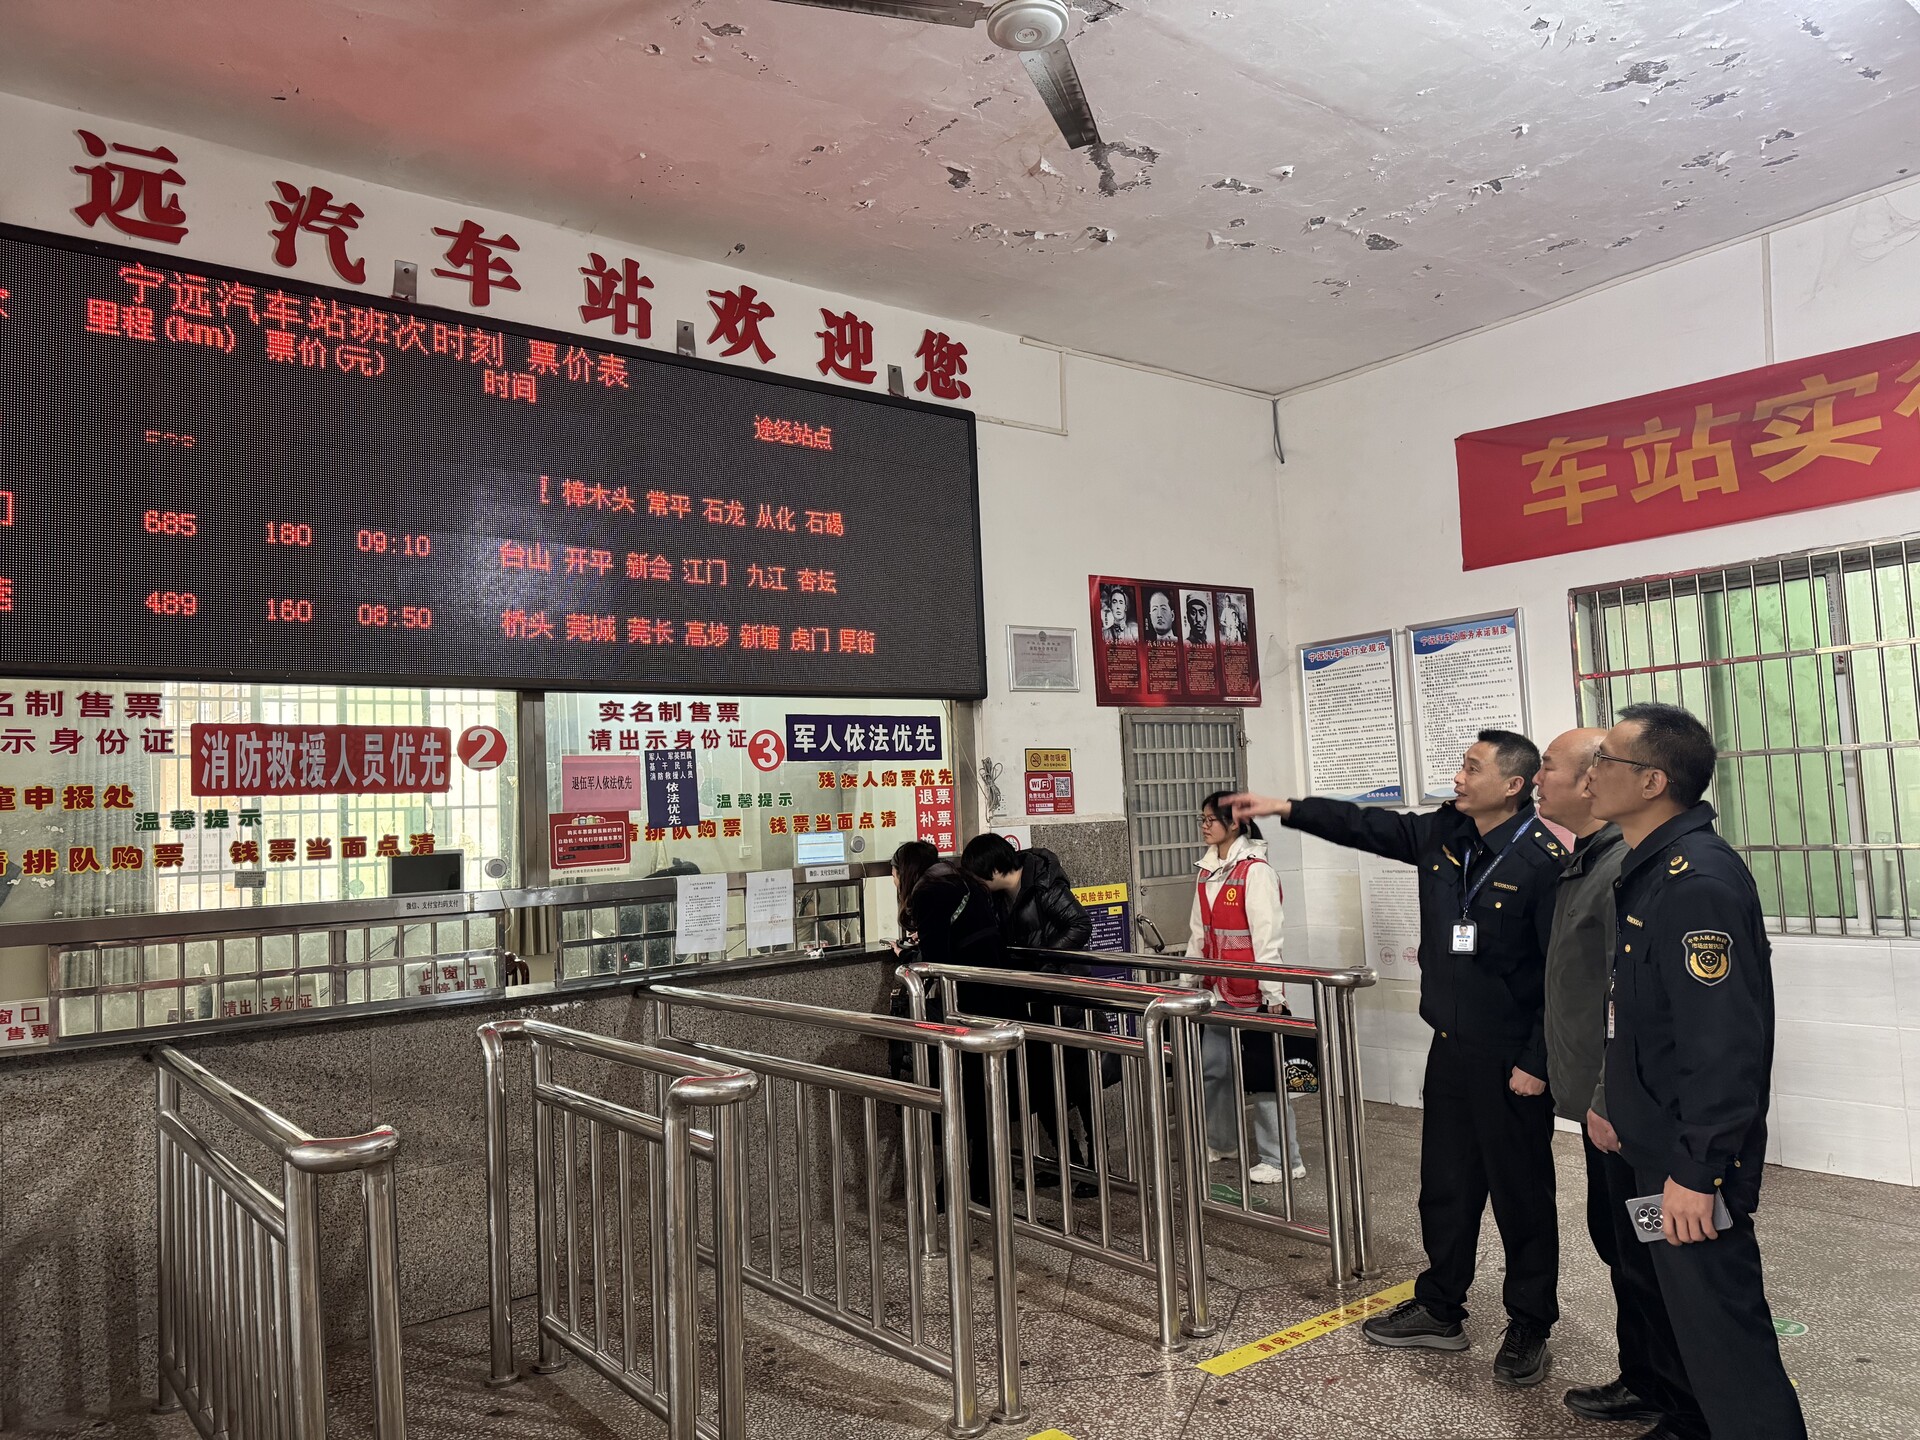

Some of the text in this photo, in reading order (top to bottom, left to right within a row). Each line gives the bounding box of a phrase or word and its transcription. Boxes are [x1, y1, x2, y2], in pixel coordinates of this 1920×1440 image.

[72, 128, 971, 400] 远汽车站欢迎您
[483, 369, 537, 404] 时间
[754, 414, 832, 451] 途经站点
[1521, 360, 1920, 526] 车站实
[562, 479, 635, 513] 樟木头
[646, 490, 691, 519] 常平
[703, 497, 745, 526] 石龙
[756, 504, 795, 532] 从化
[806, 510, 844, 536] 石碣
[144, 509, 837, 594] 685 180 09:10 台山 开平 新会 江门 九江 杏坛
[145, 590, 197, 616] 489
[266, 597, 312, 623] 160
[358, 603, 431, 629] 08:50
[501, 609, 553, 639] 桥头
[565, 612, 616, 641] 莞城
[740, 623, 779, 650] 新塘
[790, 627, 829, 651] 虎门
[839, 627, 875, 654] 厚街
[599, 701, 740, 723] 实名制售票
[0, 728, 174, 755] 示身份证
[467, 728, 498, 769] 2
[588, 728, 748, 751] 请出示身份证
[755, 733, 779, 769] 3
[793, 724, 936, 753] 军人依法优先
[201, 730, 446, 789] 消防救援人员优先
[572, 775, 632, 791] 退伍军人依法优先
[650, 770, 694, 781] 消防救援人员
[818, 769, 953, 789] 残疾人购票优先
[666, 782, 682, 826] 依法优先
[717, 792, 793, 809] 温馨提示
[919, 788, 951, 805] 退票
[134, 808, 262, 832] 温馨提示
[769, 810, 897, 834] 钱票当面点清
[919, 810, 952, 827] 补票
[0, 843, 185, 875] 排队购票
[229, 833, 436, 864] 钱票当面点清
[406, 900, 459, 910] 微信、支付宝扫码支付
